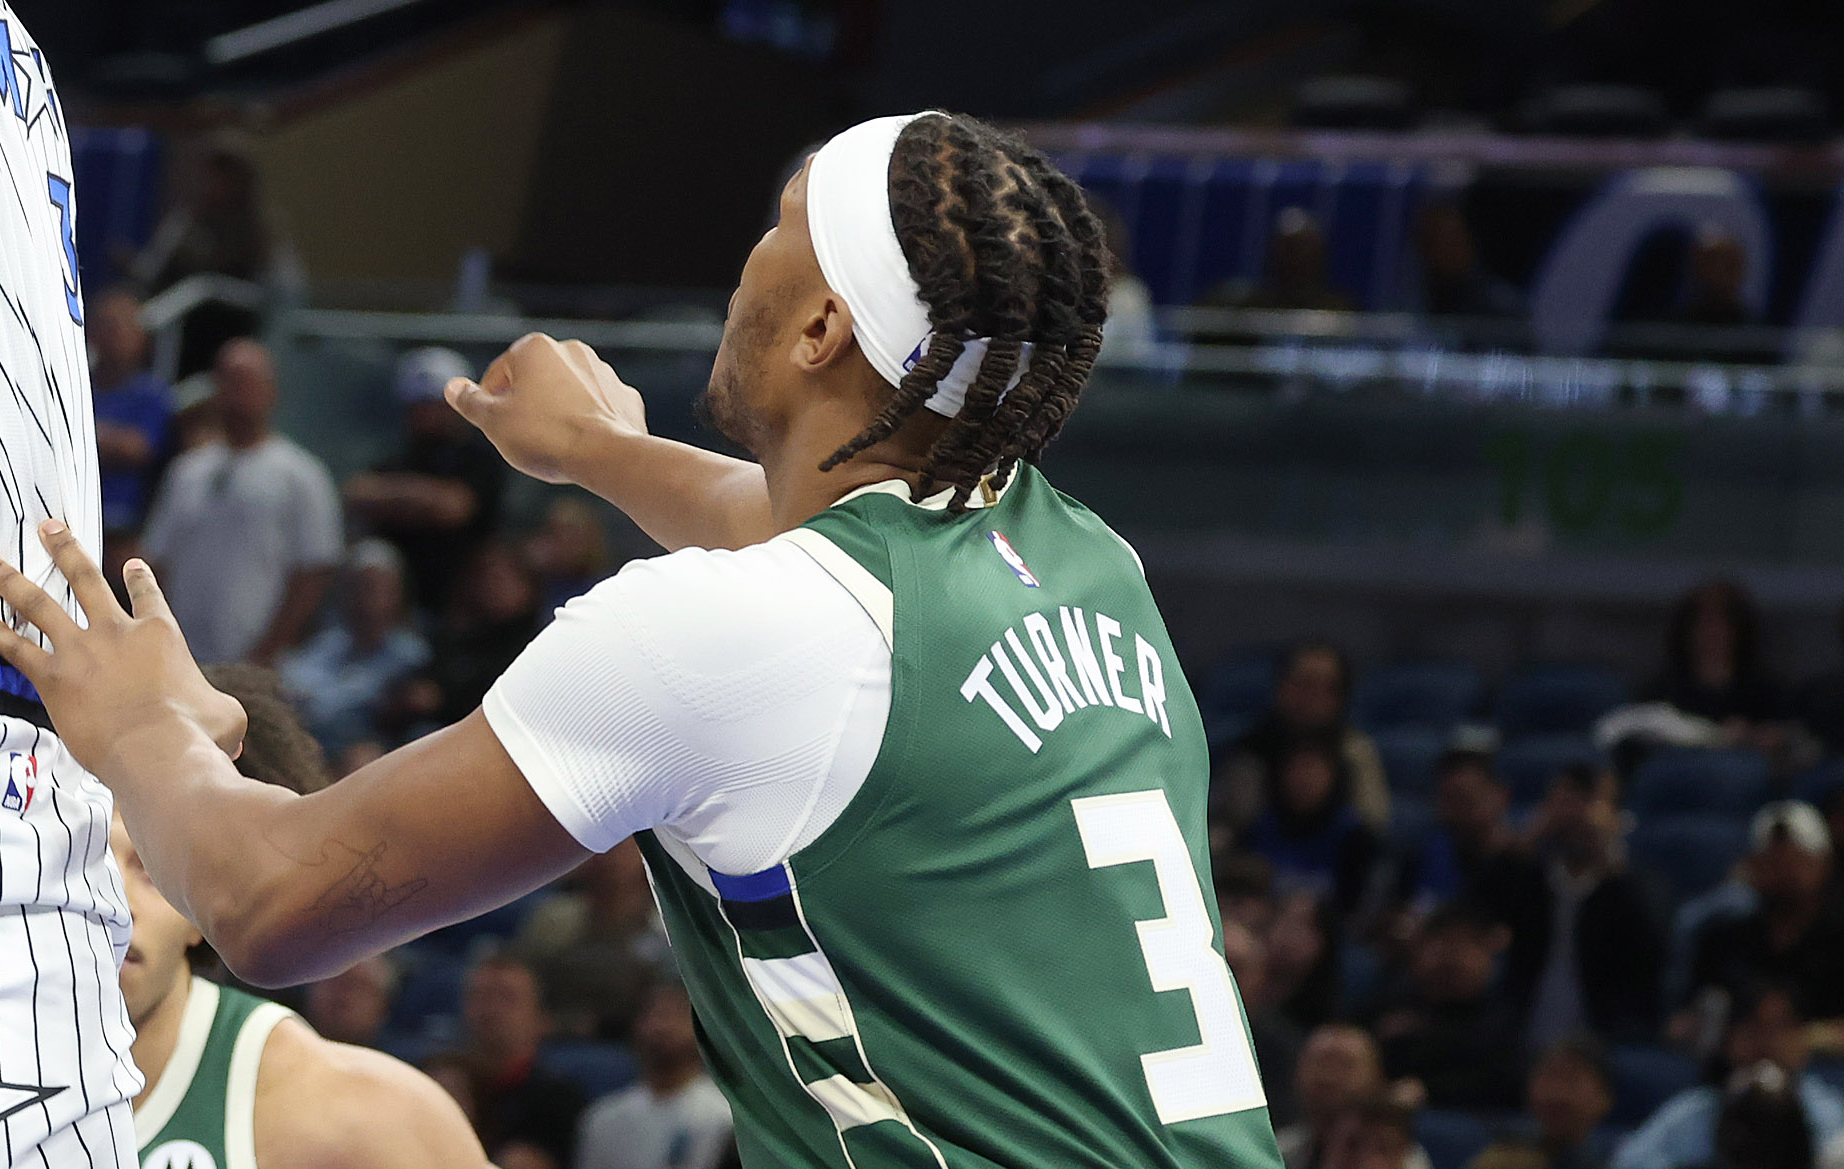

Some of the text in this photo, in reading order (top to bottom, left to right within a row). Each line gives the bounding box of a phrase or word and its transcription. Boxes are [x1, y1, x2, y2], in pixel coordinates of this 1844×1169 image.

[1480, 431, 1685, 535] 105
[959, 605, 1172, 754] TURNER
[1069, 788, 1268, 1126] 3
